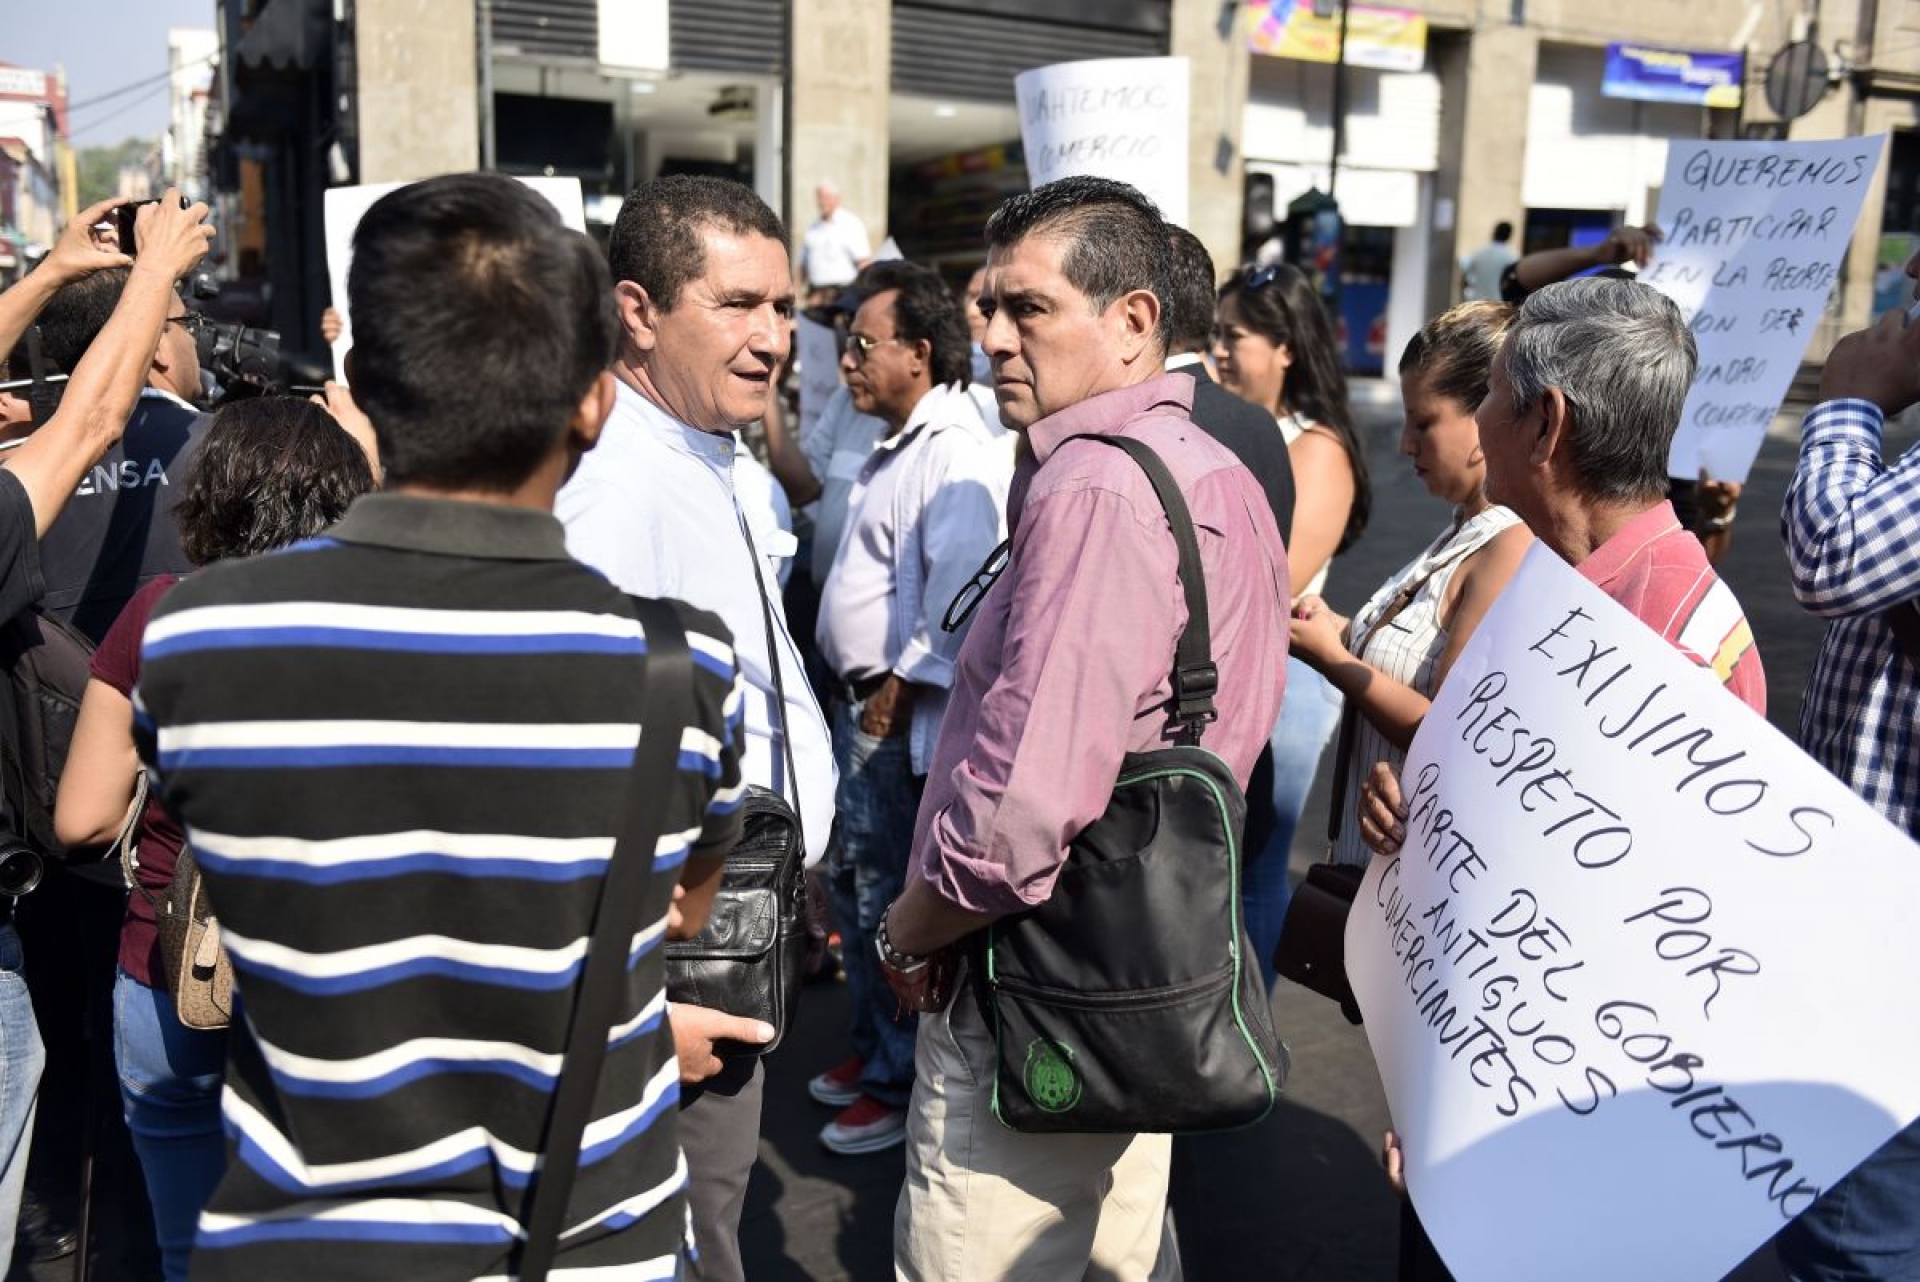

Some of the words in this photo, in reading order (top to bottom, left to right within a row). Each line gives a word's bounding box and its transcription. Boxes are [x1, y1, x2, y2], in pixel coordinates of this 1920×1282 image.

[1650, 261, 1703, 283] EN
[1712, 259, 1748, 287] LA
[1664, 206, 1838, 247] PARTICIPAR
[1456, 671, 1633, 870] RESPETO
[1623, 886, 1761, 1020] POR
[1528, 606, 1835, 858] EXIJIMOS
[1408, 763, 1488, 894] PARTE
[1486, 888, 1585, 1002] DEL
[1423, 898, 1617, 1115] ANTIGUOS
